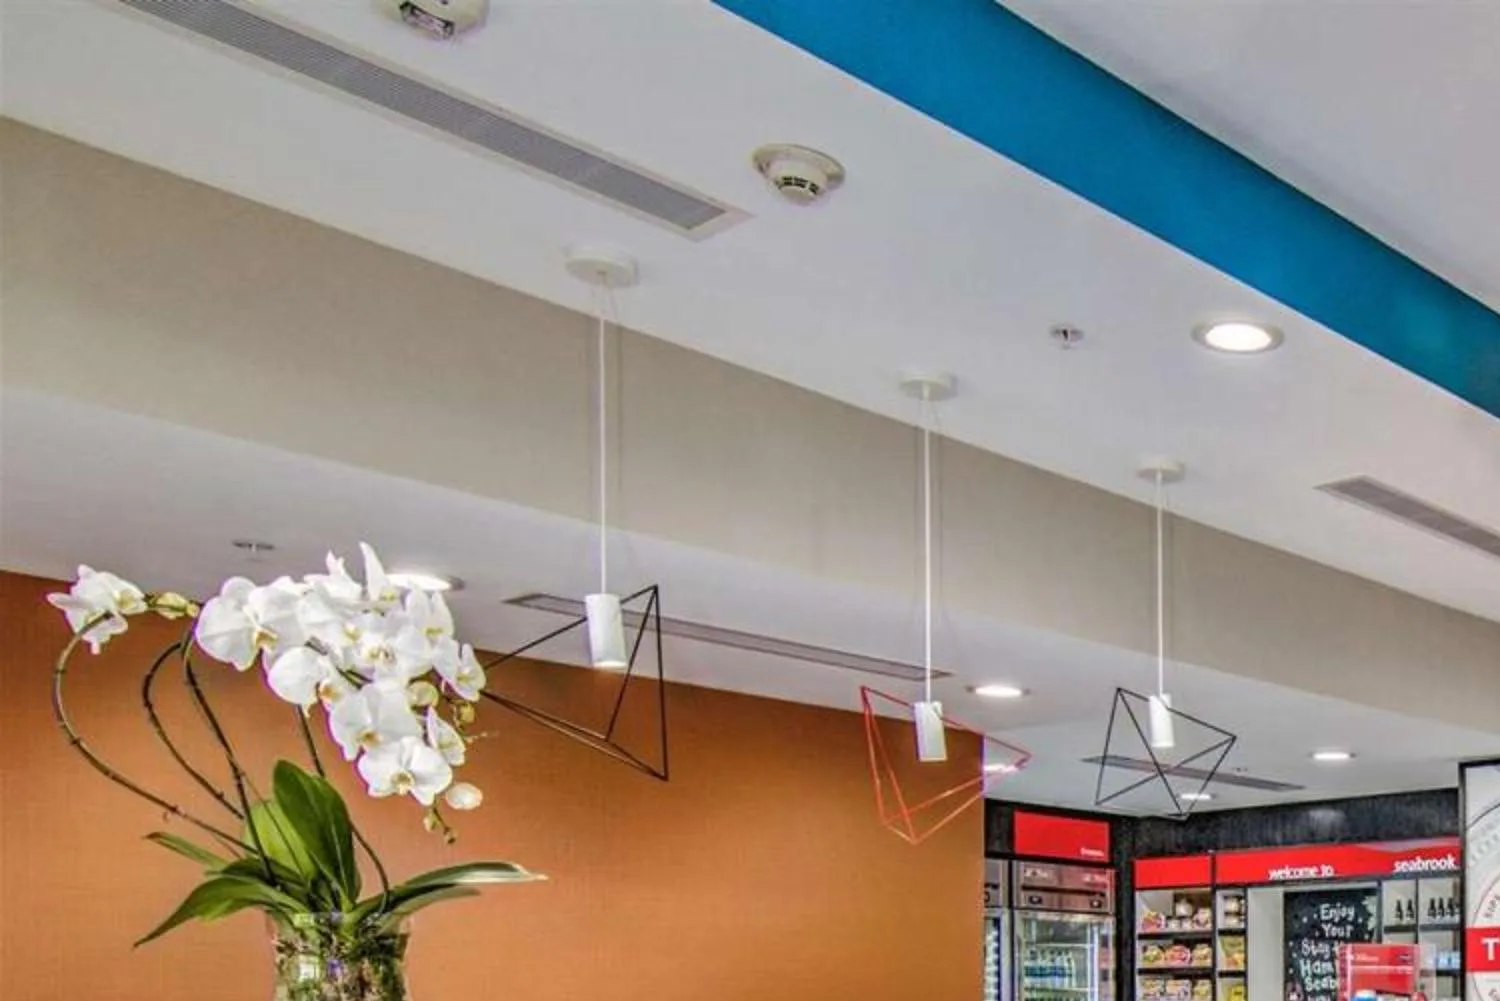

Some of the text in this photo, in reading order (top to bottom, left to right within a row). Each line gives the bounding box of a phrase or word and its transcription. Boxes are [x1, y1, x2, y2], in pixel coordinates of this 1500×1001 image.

[1268, 864, 1319, 880] welcome
[1321, 864, 1335, 877] to
[1320, 902, 1355, 922] Enjoy
[1321, 923, 1354, 938] Your
[1301, 938, 1330, 959] Stay
